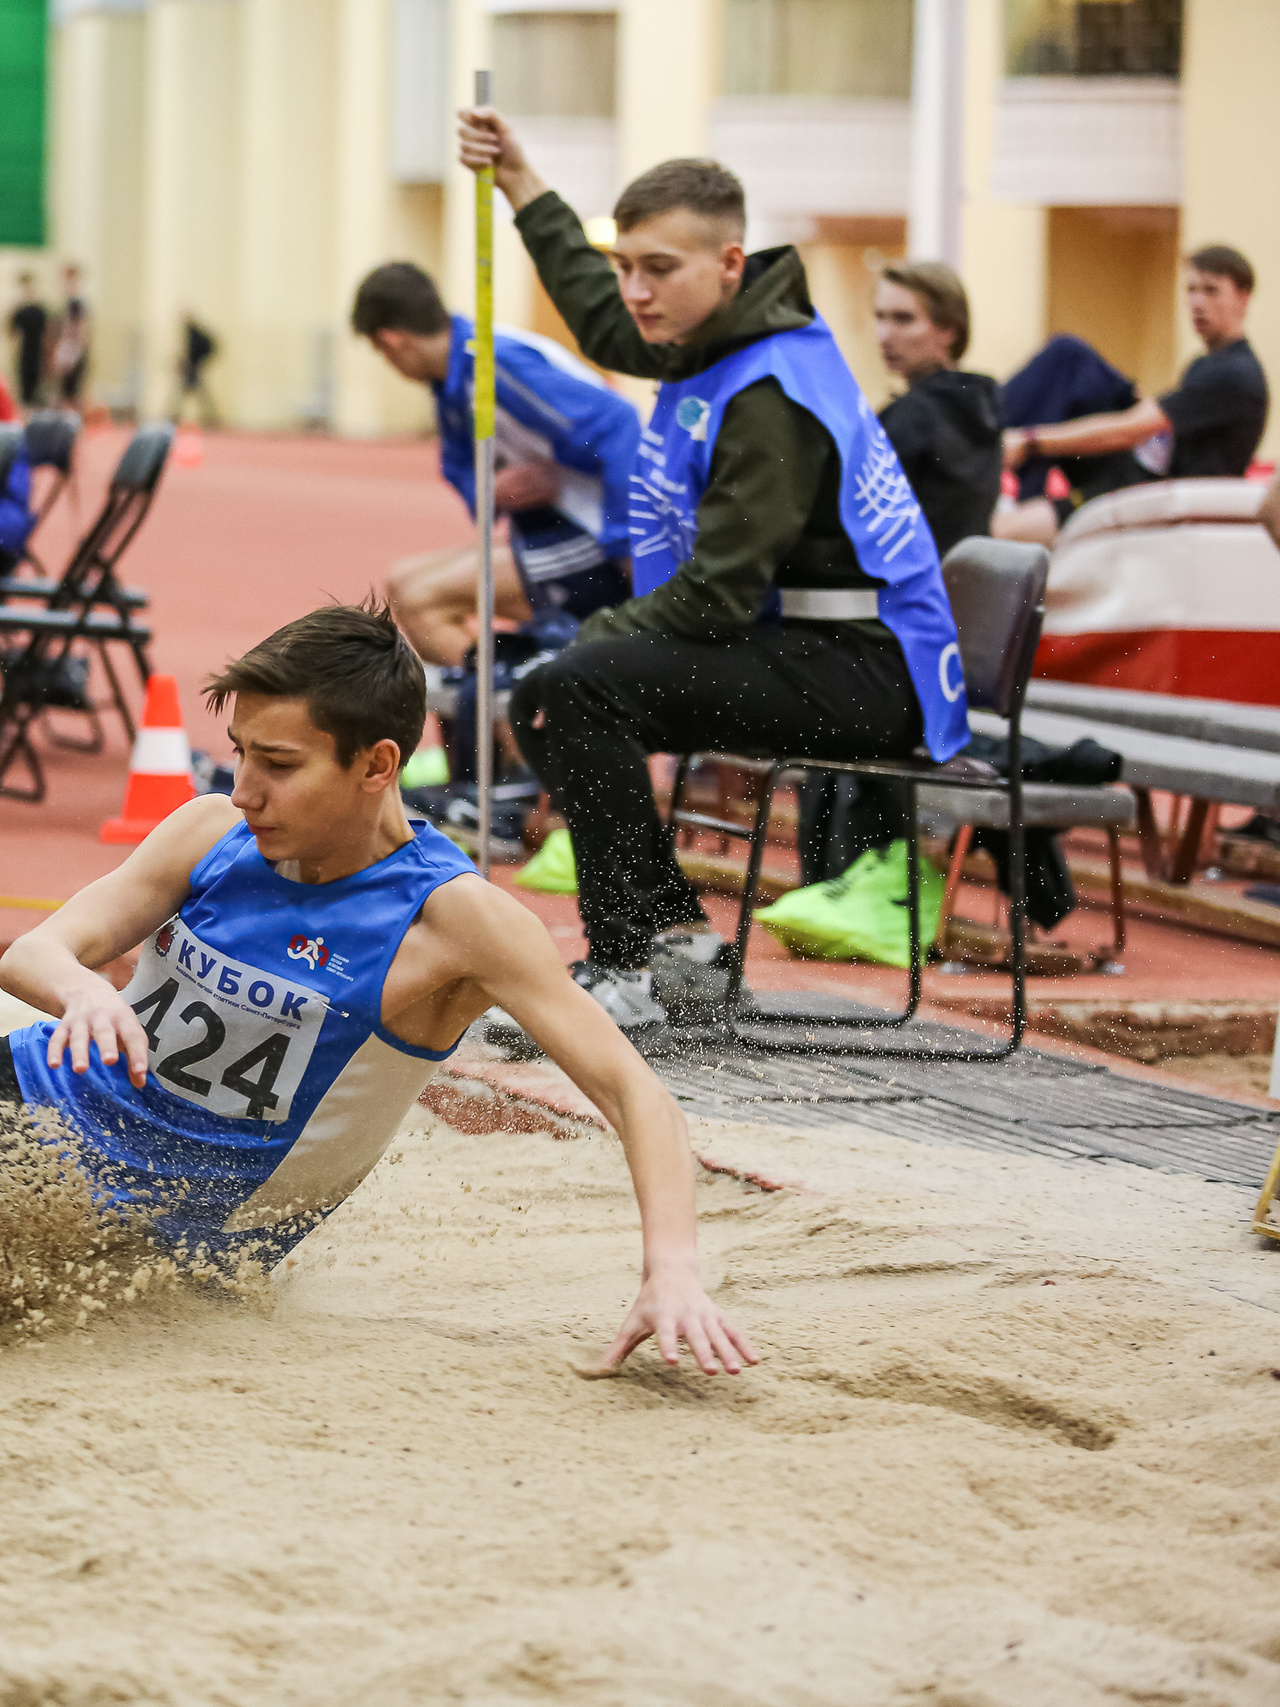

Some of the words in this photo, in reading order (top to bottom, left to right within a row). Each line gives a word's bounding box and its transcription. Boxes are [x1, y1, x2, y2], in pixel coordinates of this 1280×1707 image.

[177, 937, 309, 1021] КУБОК
[240, 1004, 301, 1030] Санкт-Петербурга
[131, 976, 292, 1120] 424
